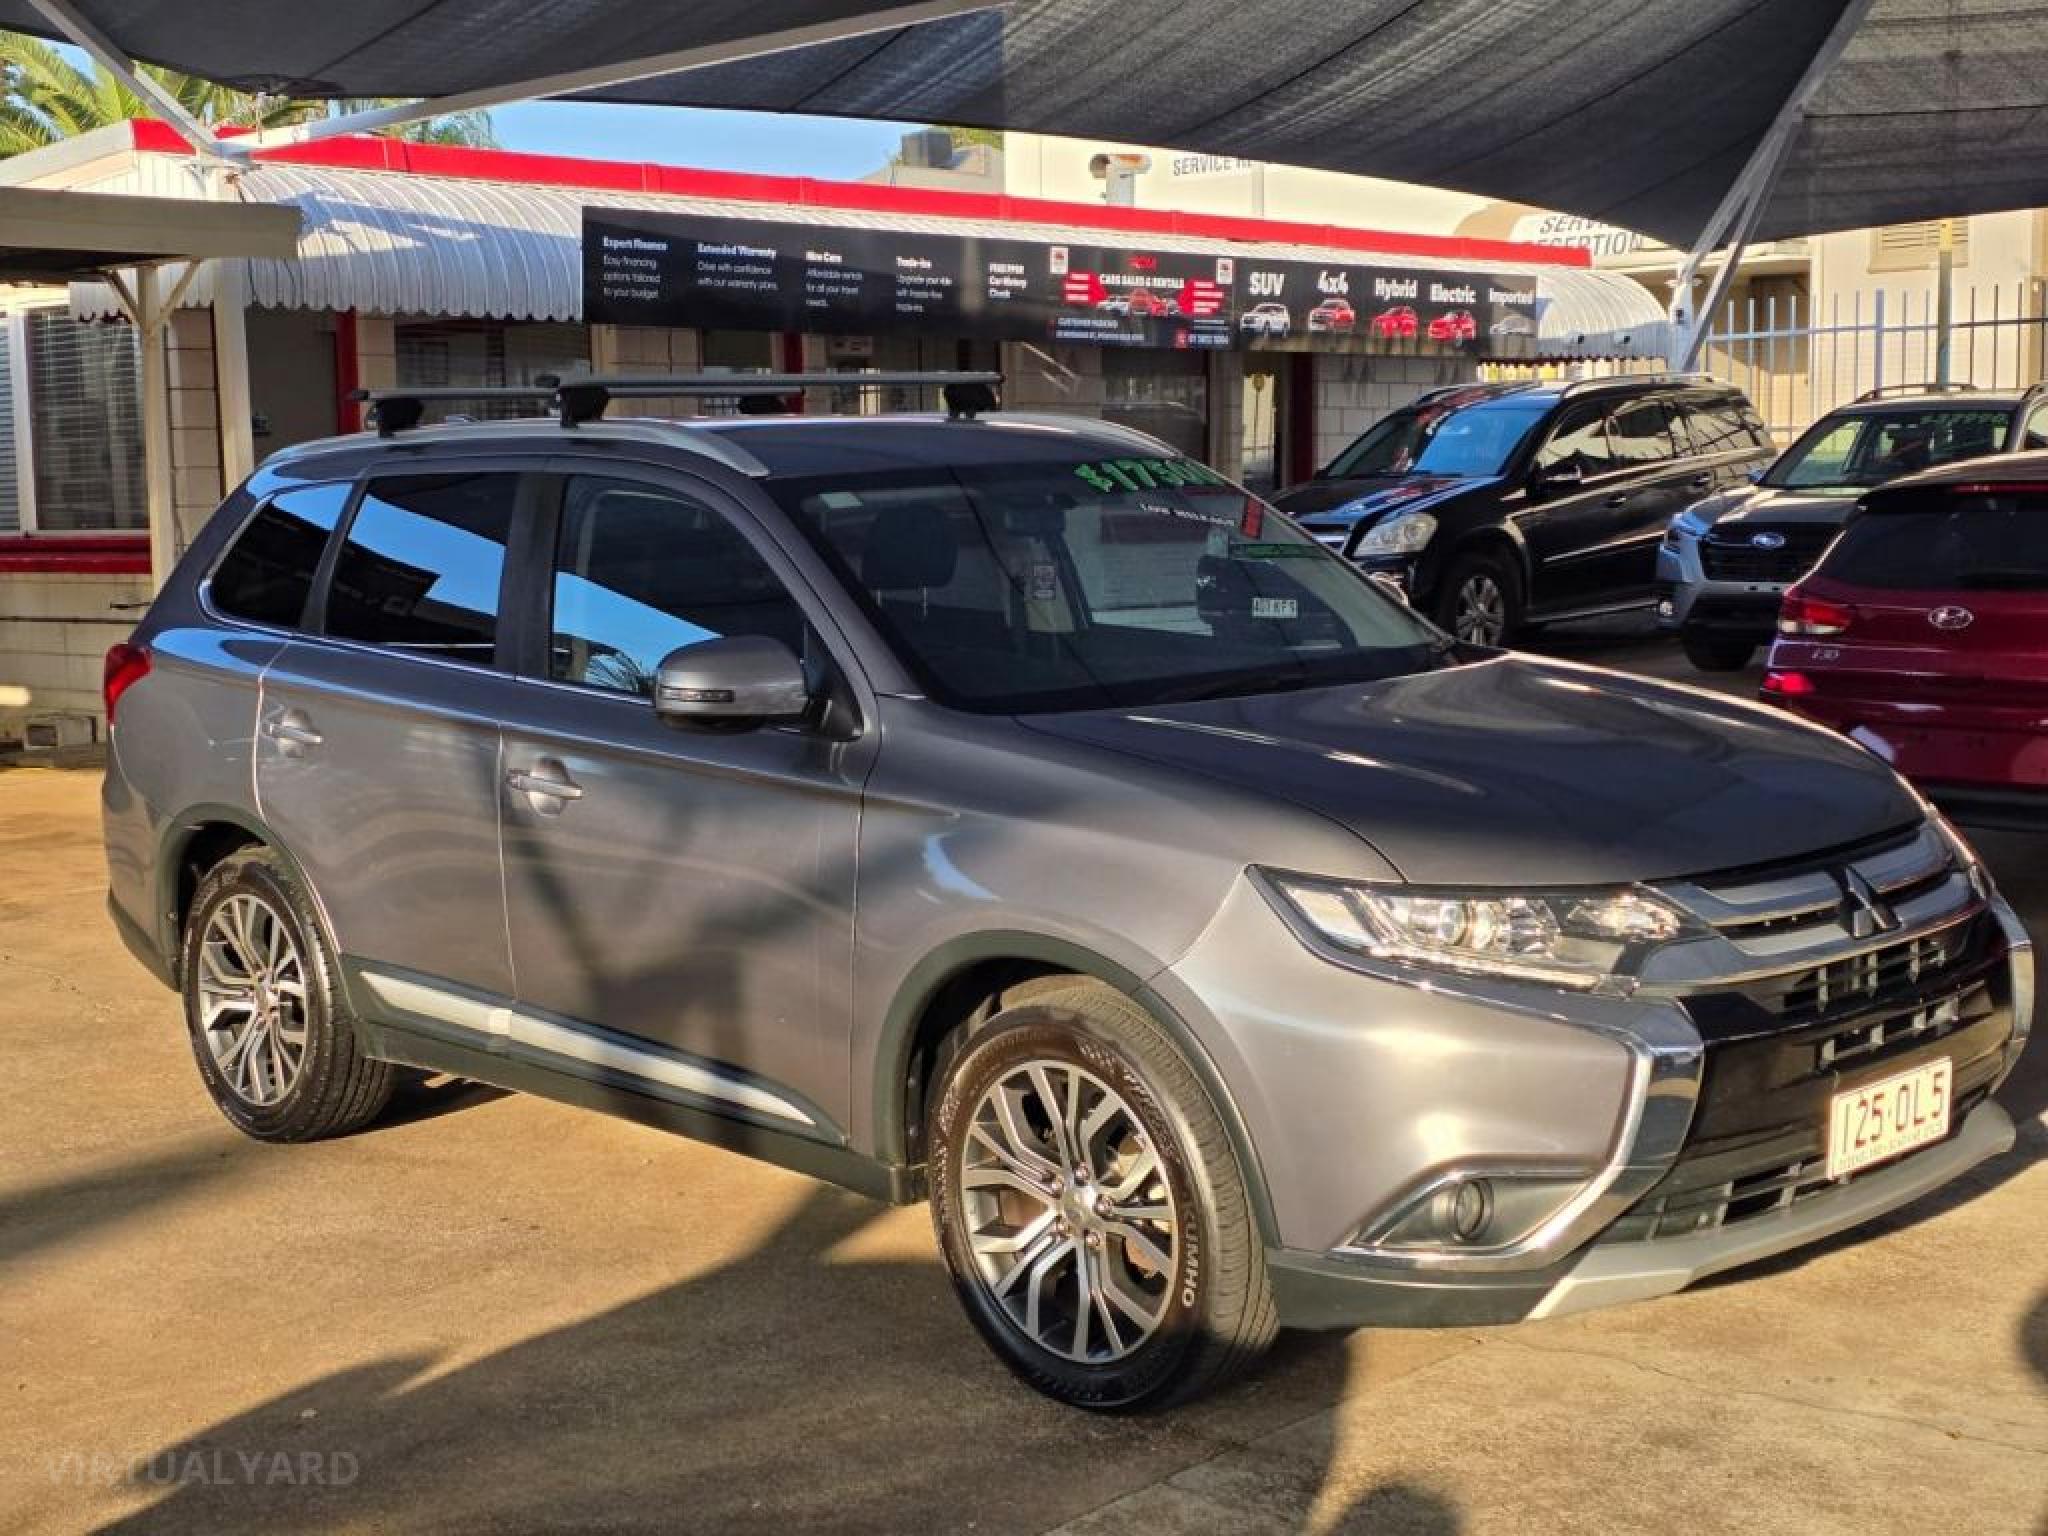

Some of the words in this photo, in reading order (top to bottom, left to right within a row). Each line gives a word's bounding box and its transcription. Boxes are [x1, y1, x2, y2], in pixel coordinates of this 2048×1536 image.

[1173, 156, 1231, 176] SERVICE
[697, 242, 737, 255] Extended
[737, 245, 777, 260] Warranty
[1249, 270, 1285, 297] SUV
[1317, 269, 1349, 294] 4x4
[1375, 277, 1418, 301] Hybrid
[1430, 283, 1477, 303] Electric
[1182, 1204, 1201, 1308] KUMHO
